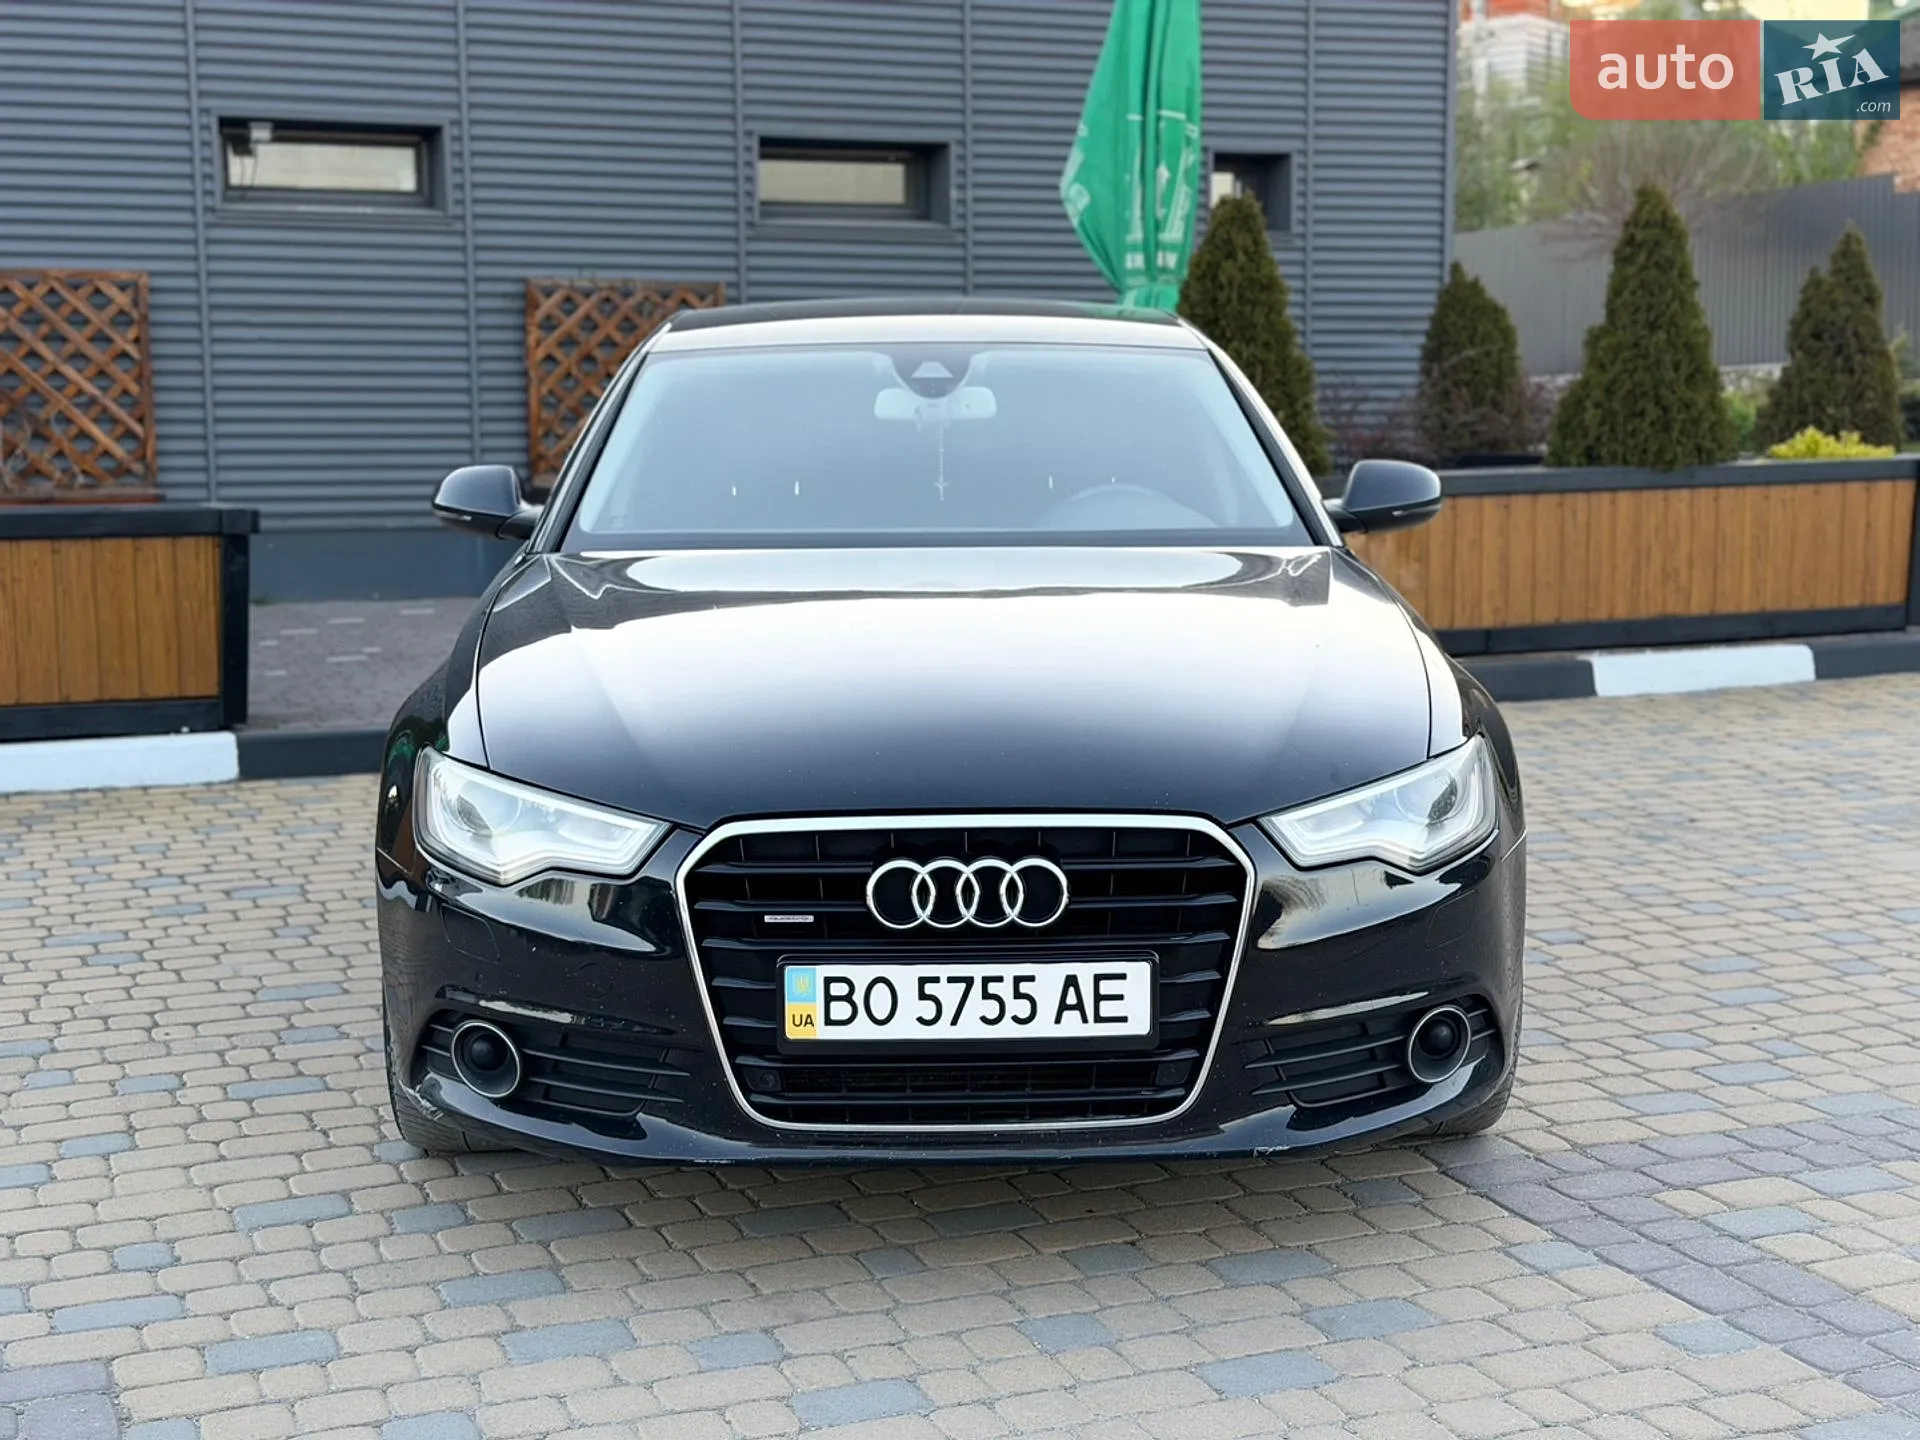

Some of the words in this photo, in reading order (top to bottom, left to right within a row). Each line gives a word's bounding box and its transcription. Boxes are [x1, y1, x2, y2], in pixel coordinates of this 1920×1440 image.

[823, 975, 899, 1027] BO
[915, 975, 1038, 1027] 5755
[1053, 972, 1129, 1025] AE
[791, 1013, 815, 1028] UA
